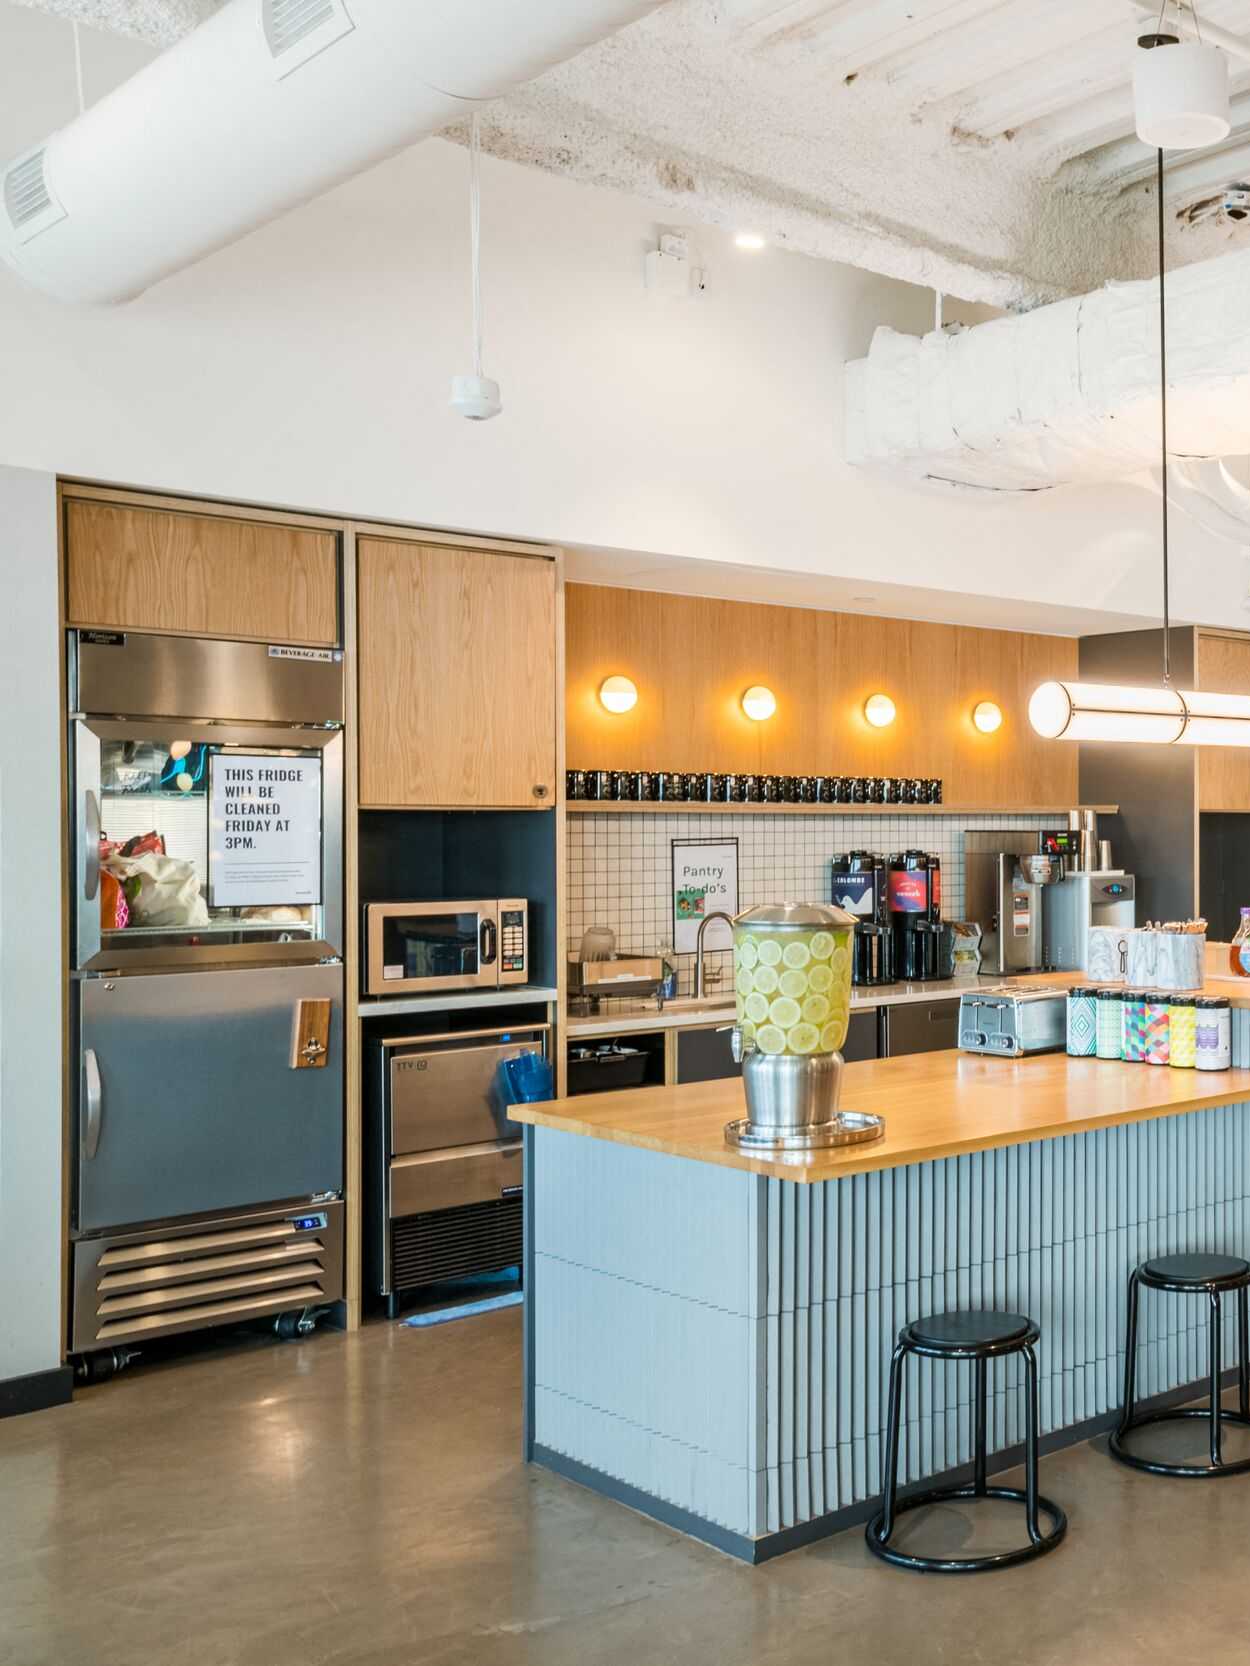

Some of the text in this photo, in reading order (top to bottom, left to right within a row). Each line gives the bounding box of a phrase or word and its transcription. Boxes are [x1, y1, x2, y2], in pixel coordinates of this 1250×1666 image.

[225, 769, 304, 782] THIS FRIDGE
[258, 786, 275, 798] BE
[225, 803, 280, 815] CLEANED
[225, 820, 291, 832] FRIDAY AT
[225, 837, 257, 849] 3PM.
[683, 866, 724, 879] Pantry
[682, 883, 727, 896] To-do's
